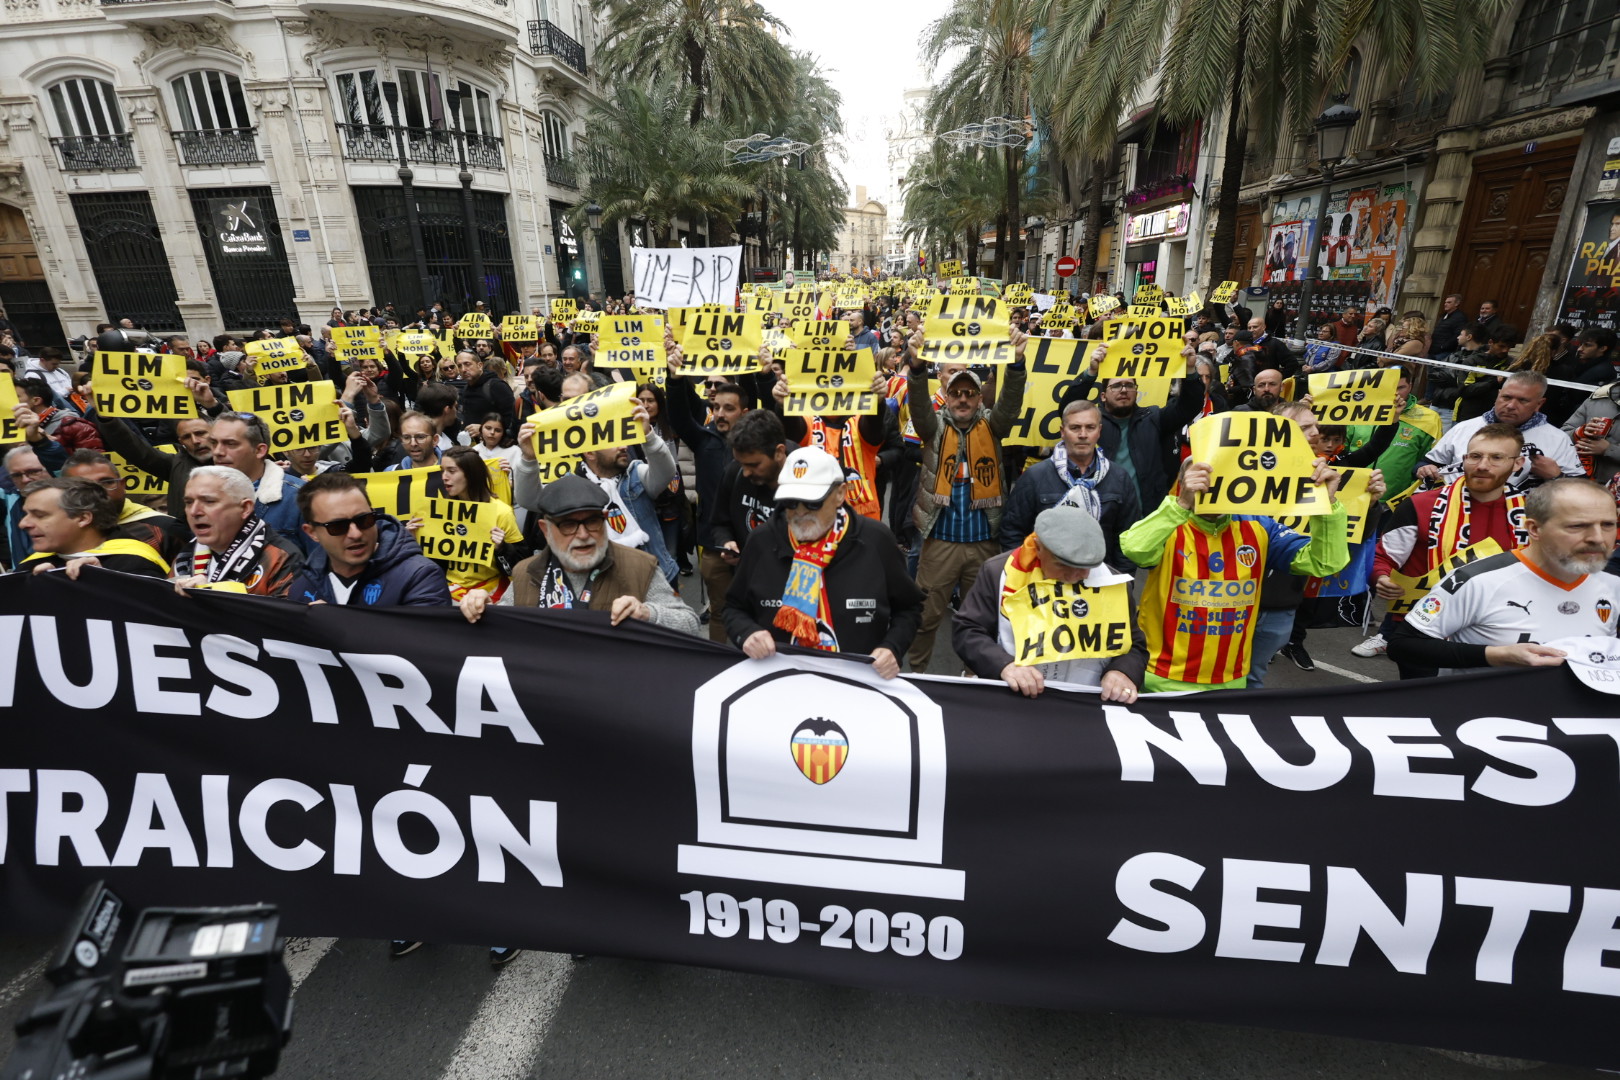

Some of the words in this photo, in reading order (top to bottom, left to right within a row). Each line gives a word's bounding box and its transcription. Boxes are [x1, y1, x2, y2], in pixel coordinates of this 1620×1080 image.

[1011, 284, 1028, 292] LIM
[1141, 284, 1158, 292] LIM
[792, 306, 811, 316] GO
[939, 297, 997, 319] LIM
[1092, 300, 1119, 317] HOME
[1134, 306, 1155, 315] LIM
[1171, 303, 1202, 315] HOME
[464, 314, 485, 322] LIM
[508, 316, 529, 325] LIM
[693, 315, 744, 336] LIM
[1040, 320, 1072, 328] HOME
[346, 330, 366, 338] LIM
[458, 329, 491, 338] HOME
[503, 331, 536, 340] HOME
[575, 324, 599, 332] HOM
[615, 321, 643, 333] LIM
[804, 322, 838, 336] LIM
[1108, 321, 1182, 340] HOME
[261, 341, 284, 352] LIM
[343, 348, 376, 356] HOME
[922, 340, 1011, 360] HOME
[607, 350, 654, 361] HOME
[680, 354, 760, 372] HOME
[801, 352, 858, 373] LIM
[102, 354, 163, 376] LIM
[261, 358, 299, 371] HOME
[1115, 357, 1170, 377] LIM
[1327, 370, 1384, 389] LIM
[97, 394, 189, 414] HOME
[253, 384, 313, 411] LIM
[788, 391, 874, 411] HOME
[1311, 405, 1393, 422] HOME
[272, 420, 340, 447] OME
[538, 416, 636, 455] HOME
[1219, 418, 1291, 447] LIM
[1199, 476, 1316, 505] HOME
[430, 500, 478, 523] LIM
[420, 536, 492, 561] HOME
[1208, 552, 1224, 573] 6
[1176, 580, 1255, 597] CAZOO
[1177, 622, 1243, 636] ALFREDO
[1021, 622, 1126, 661] HOME
[680, 890, 964, 960] 1919-2030
